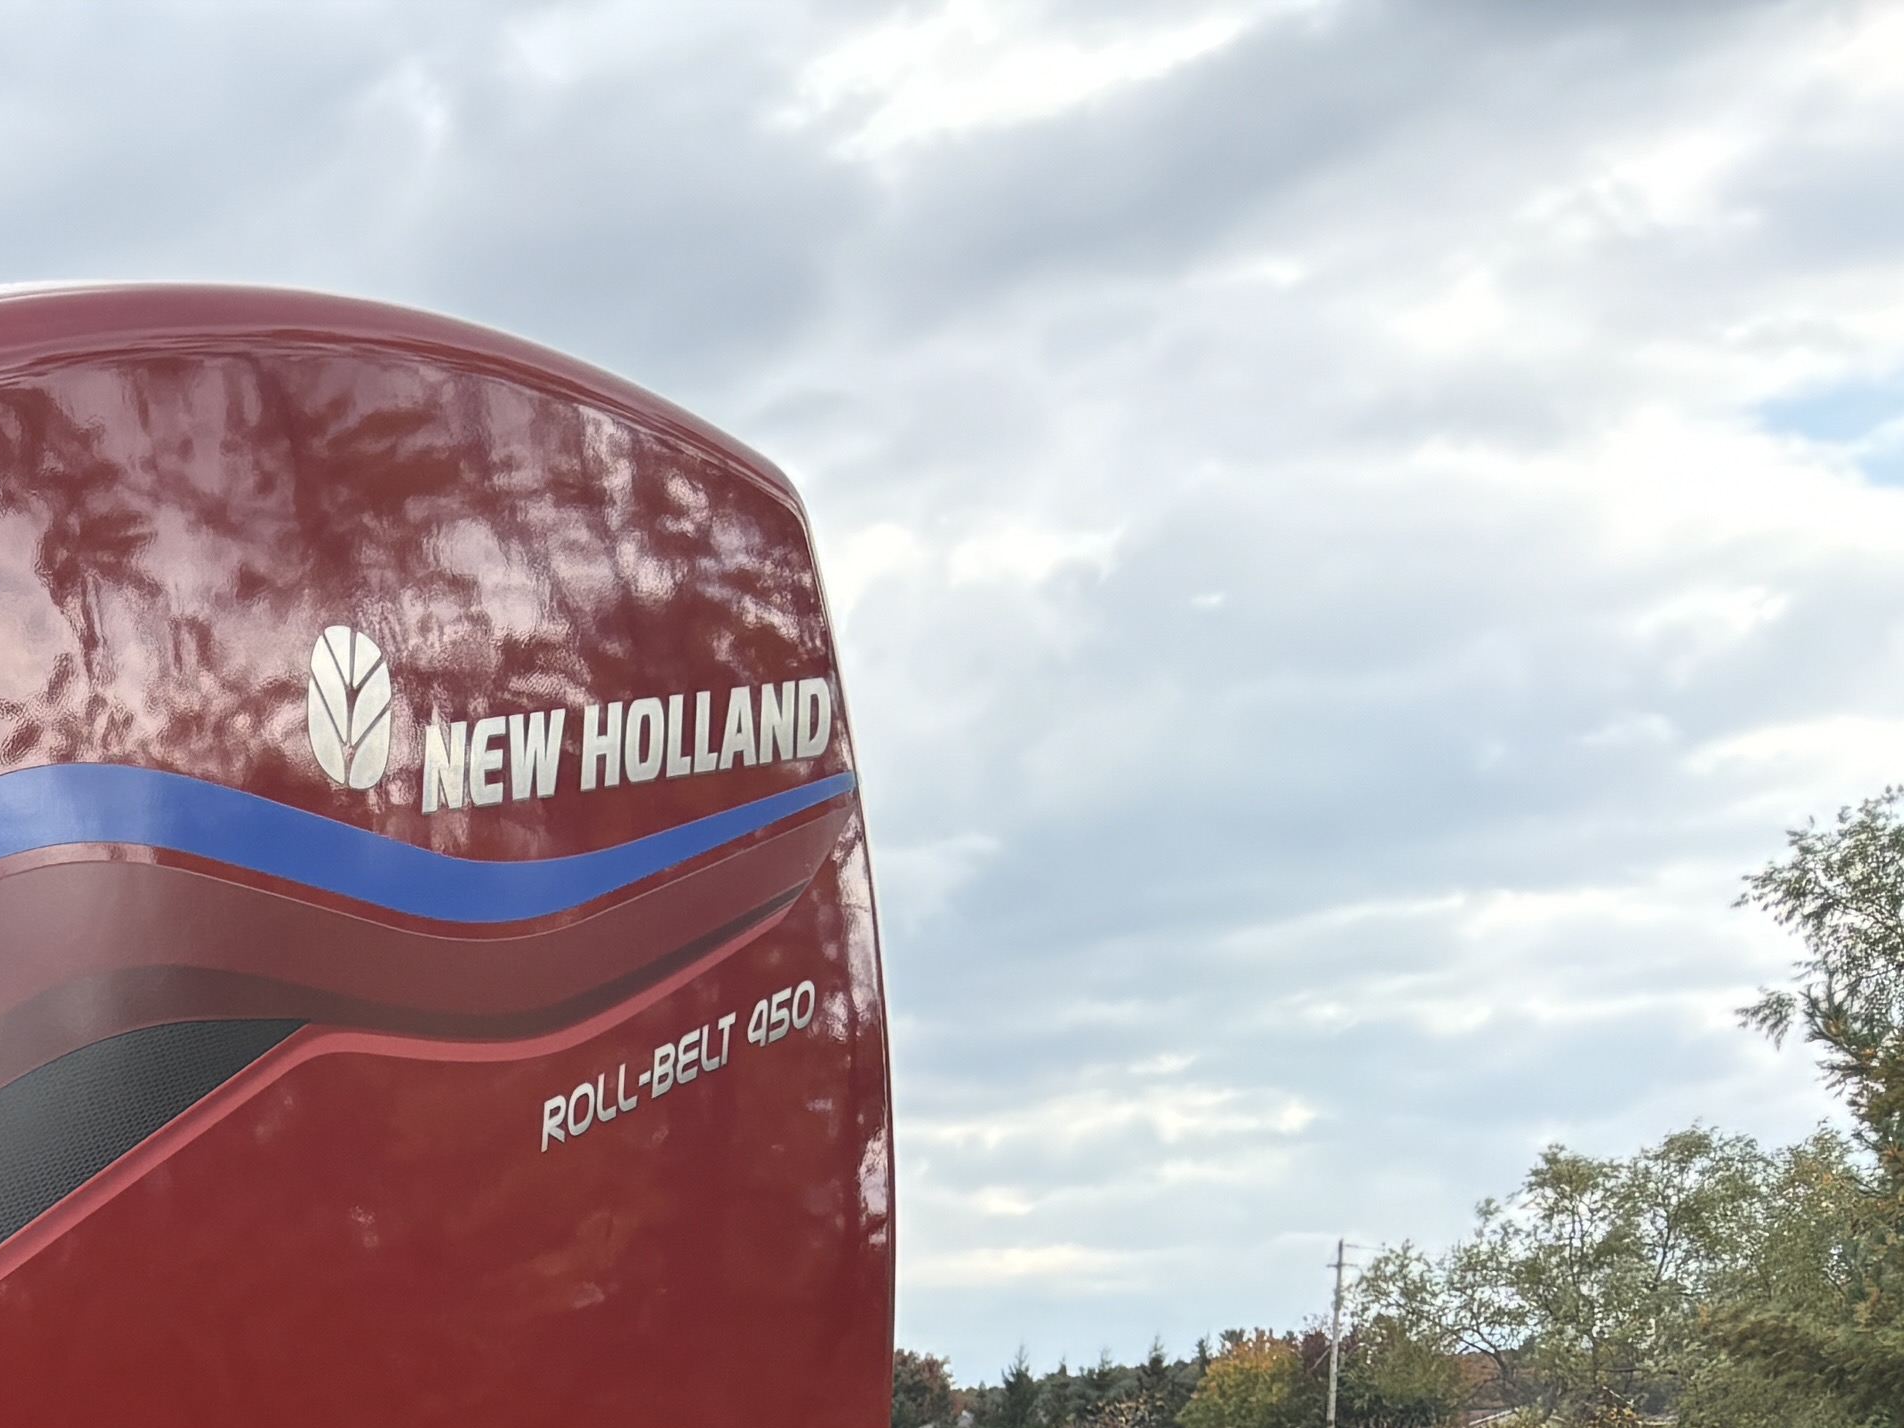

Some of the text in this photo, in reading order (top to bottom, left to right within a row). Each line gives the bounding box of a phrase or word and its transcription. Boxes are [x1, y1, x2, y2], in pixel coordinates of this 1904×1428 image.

[421, 677, 832, 815] NEW HOLLAND
[540, 980, 816, 1153] ROLL-BELT 450
